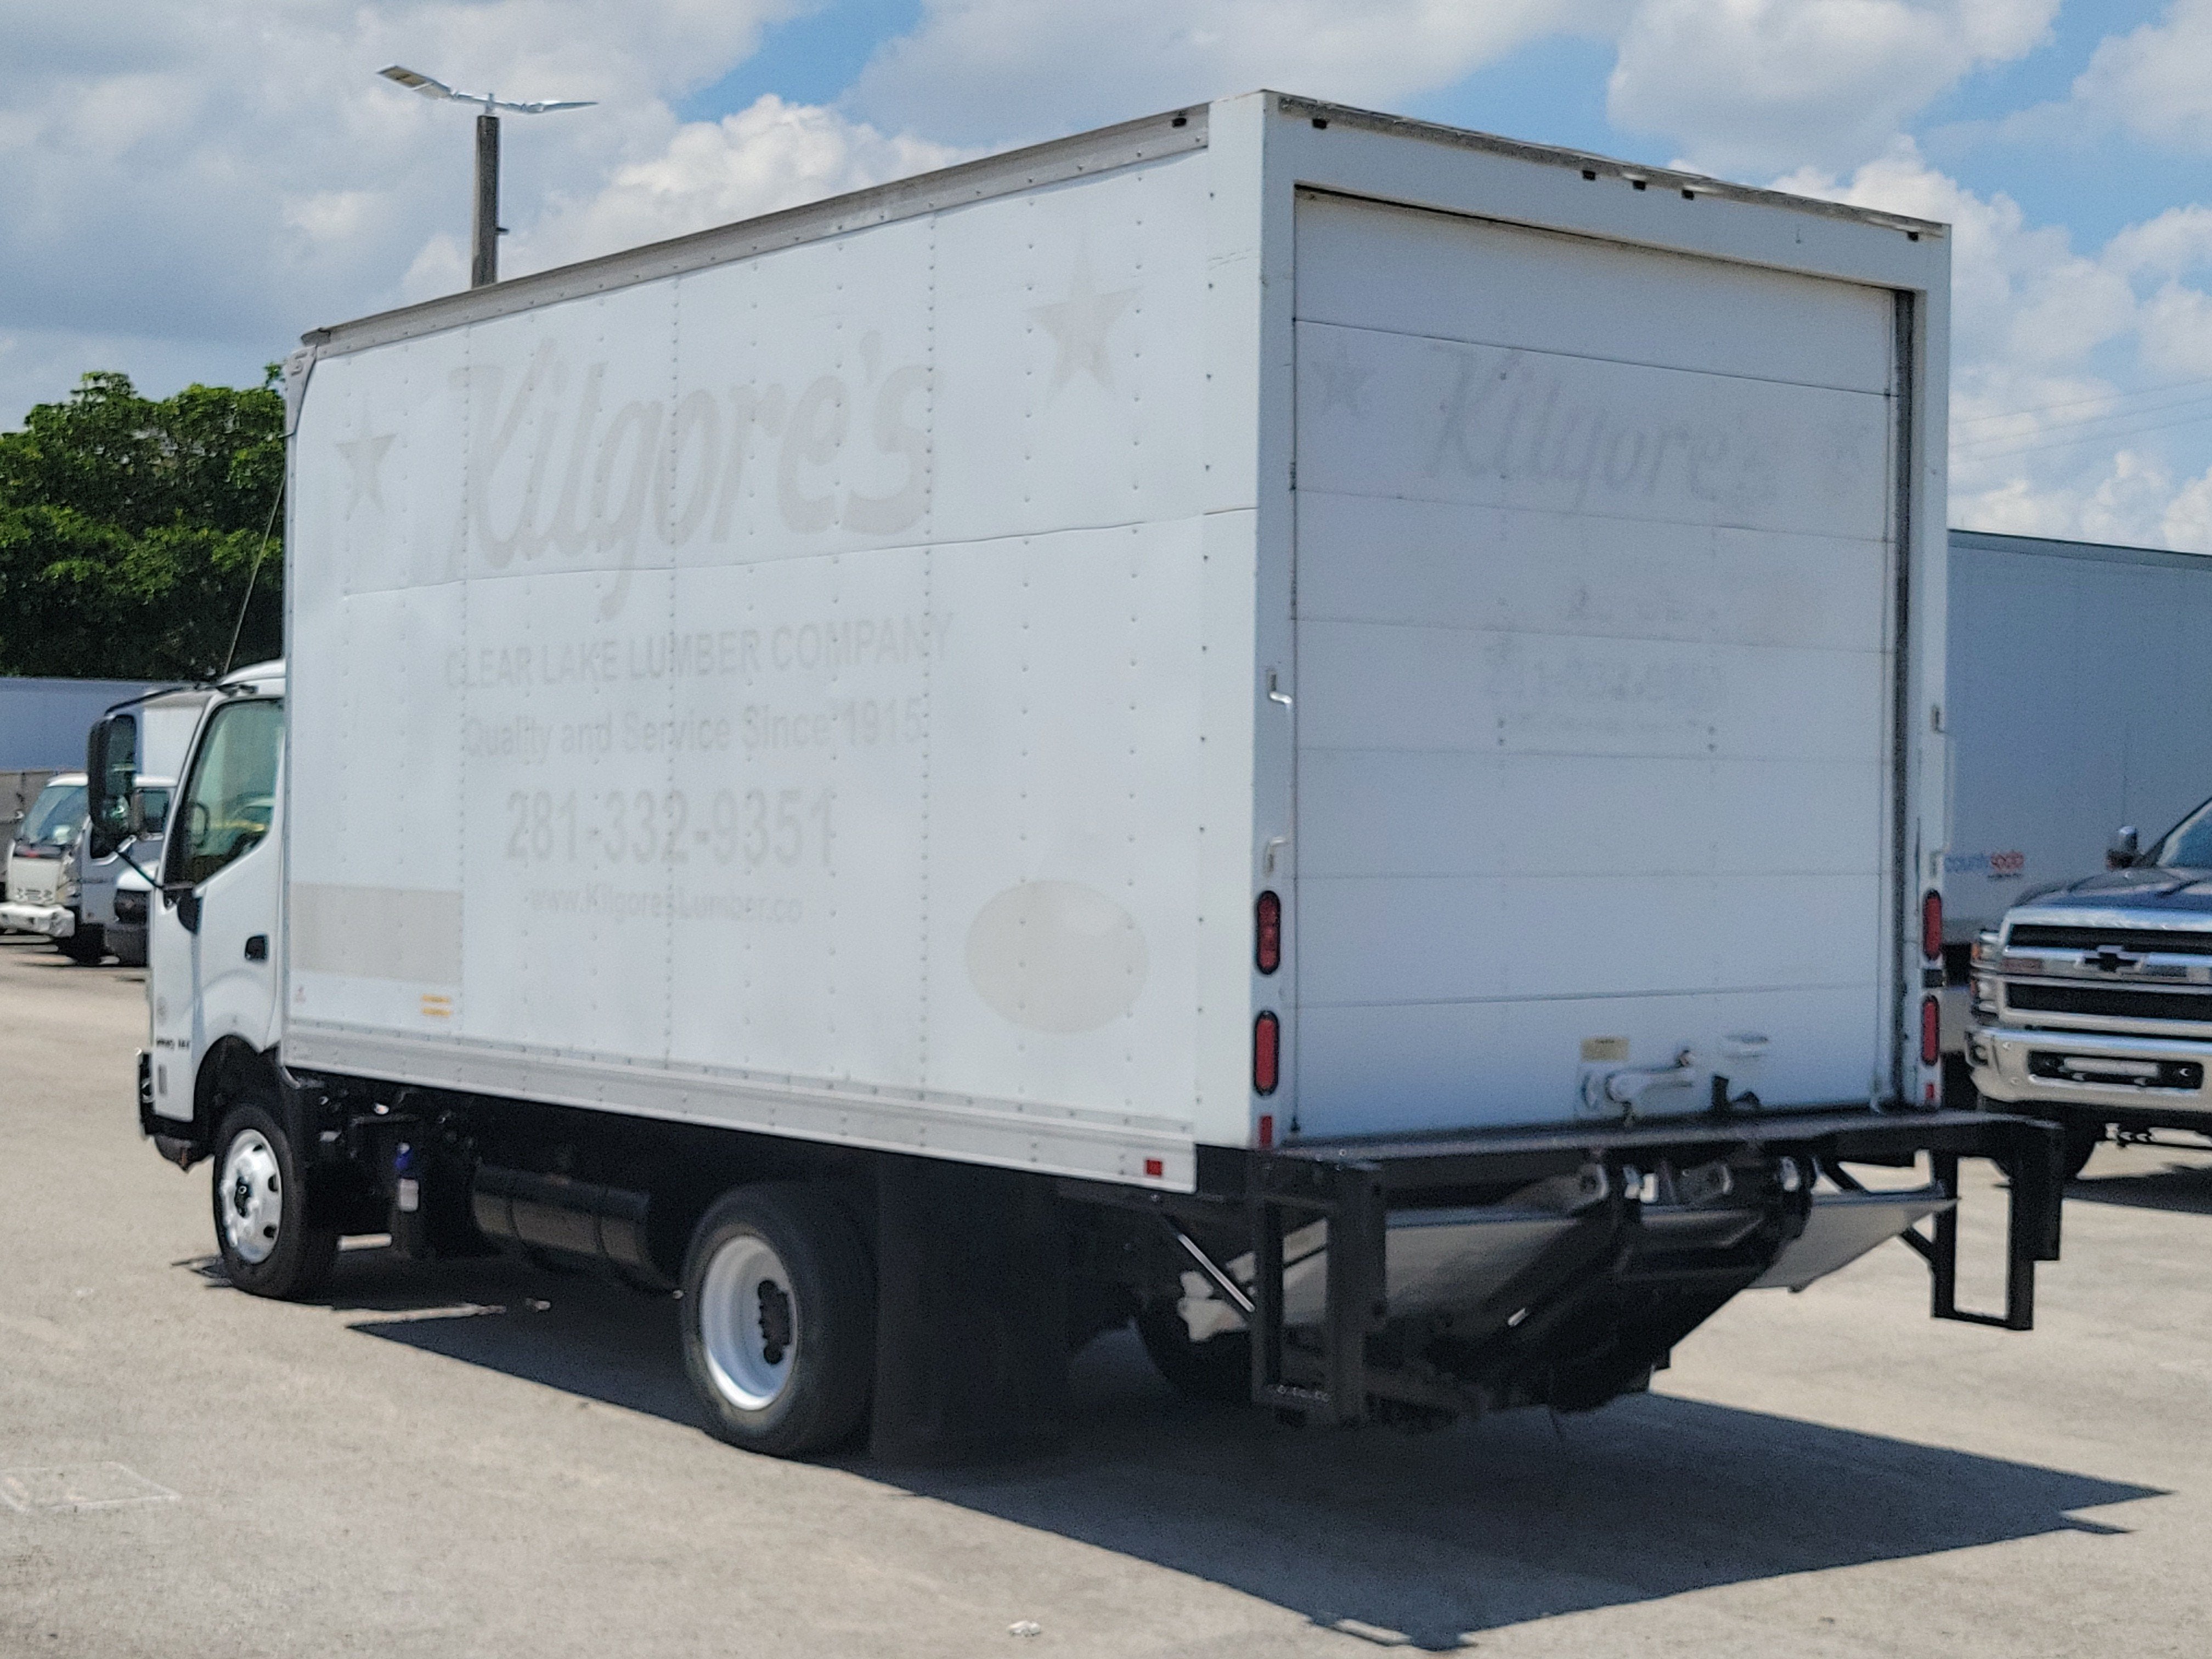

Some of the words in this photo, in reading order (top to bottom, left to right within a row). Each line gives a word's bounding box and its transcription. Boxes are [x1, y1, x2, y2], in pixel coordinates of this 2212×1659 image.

[447, 329, 945, 621] Kilgore's
[444, 646, 534, 691] CLEAR
[542, 639, 618, 685] LAKE
[629, 628, 761, 680] LUMBER
[771, 611, 955, 673] COMPANY
[464, 714, 554, 765] Quality
[561, 710, 612, 754] and
[622, 706, 731, 754] Service
[741, 702, 831, 750] Since
[842, 697, 924, 746] 1915
[504, 787, 833, 868] 281-332-9351
